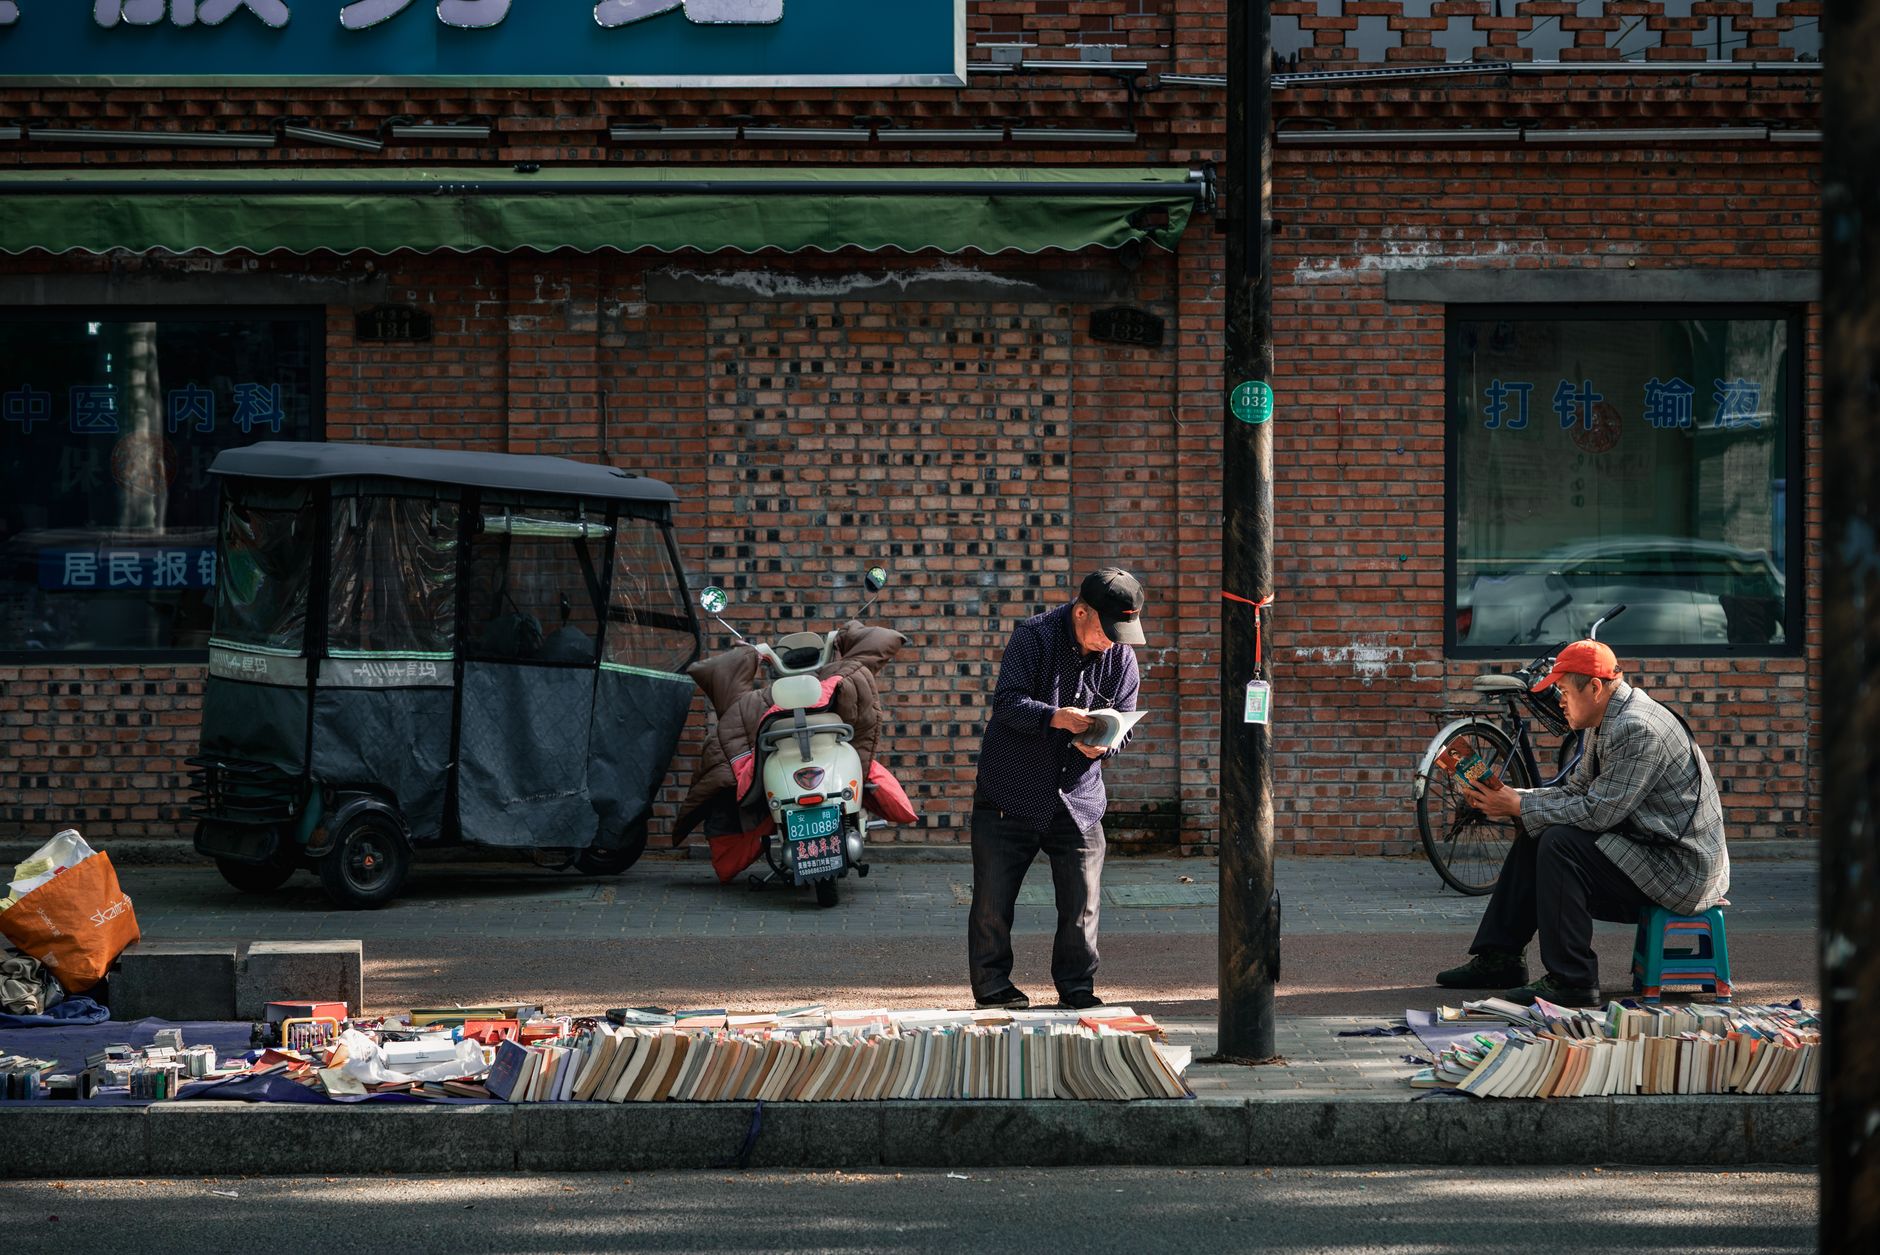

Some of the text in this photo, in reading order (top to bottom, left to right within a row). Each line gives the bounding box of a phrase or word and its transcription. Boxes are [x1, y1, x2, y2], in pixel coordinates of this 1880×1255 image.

[3, 383, 286, 434] 中医 内科
[1241, 396, 1268, 408] 032
[1483, 377, 1762, 430] 打针 输液
[790, 818, 838, 838] 8210888
